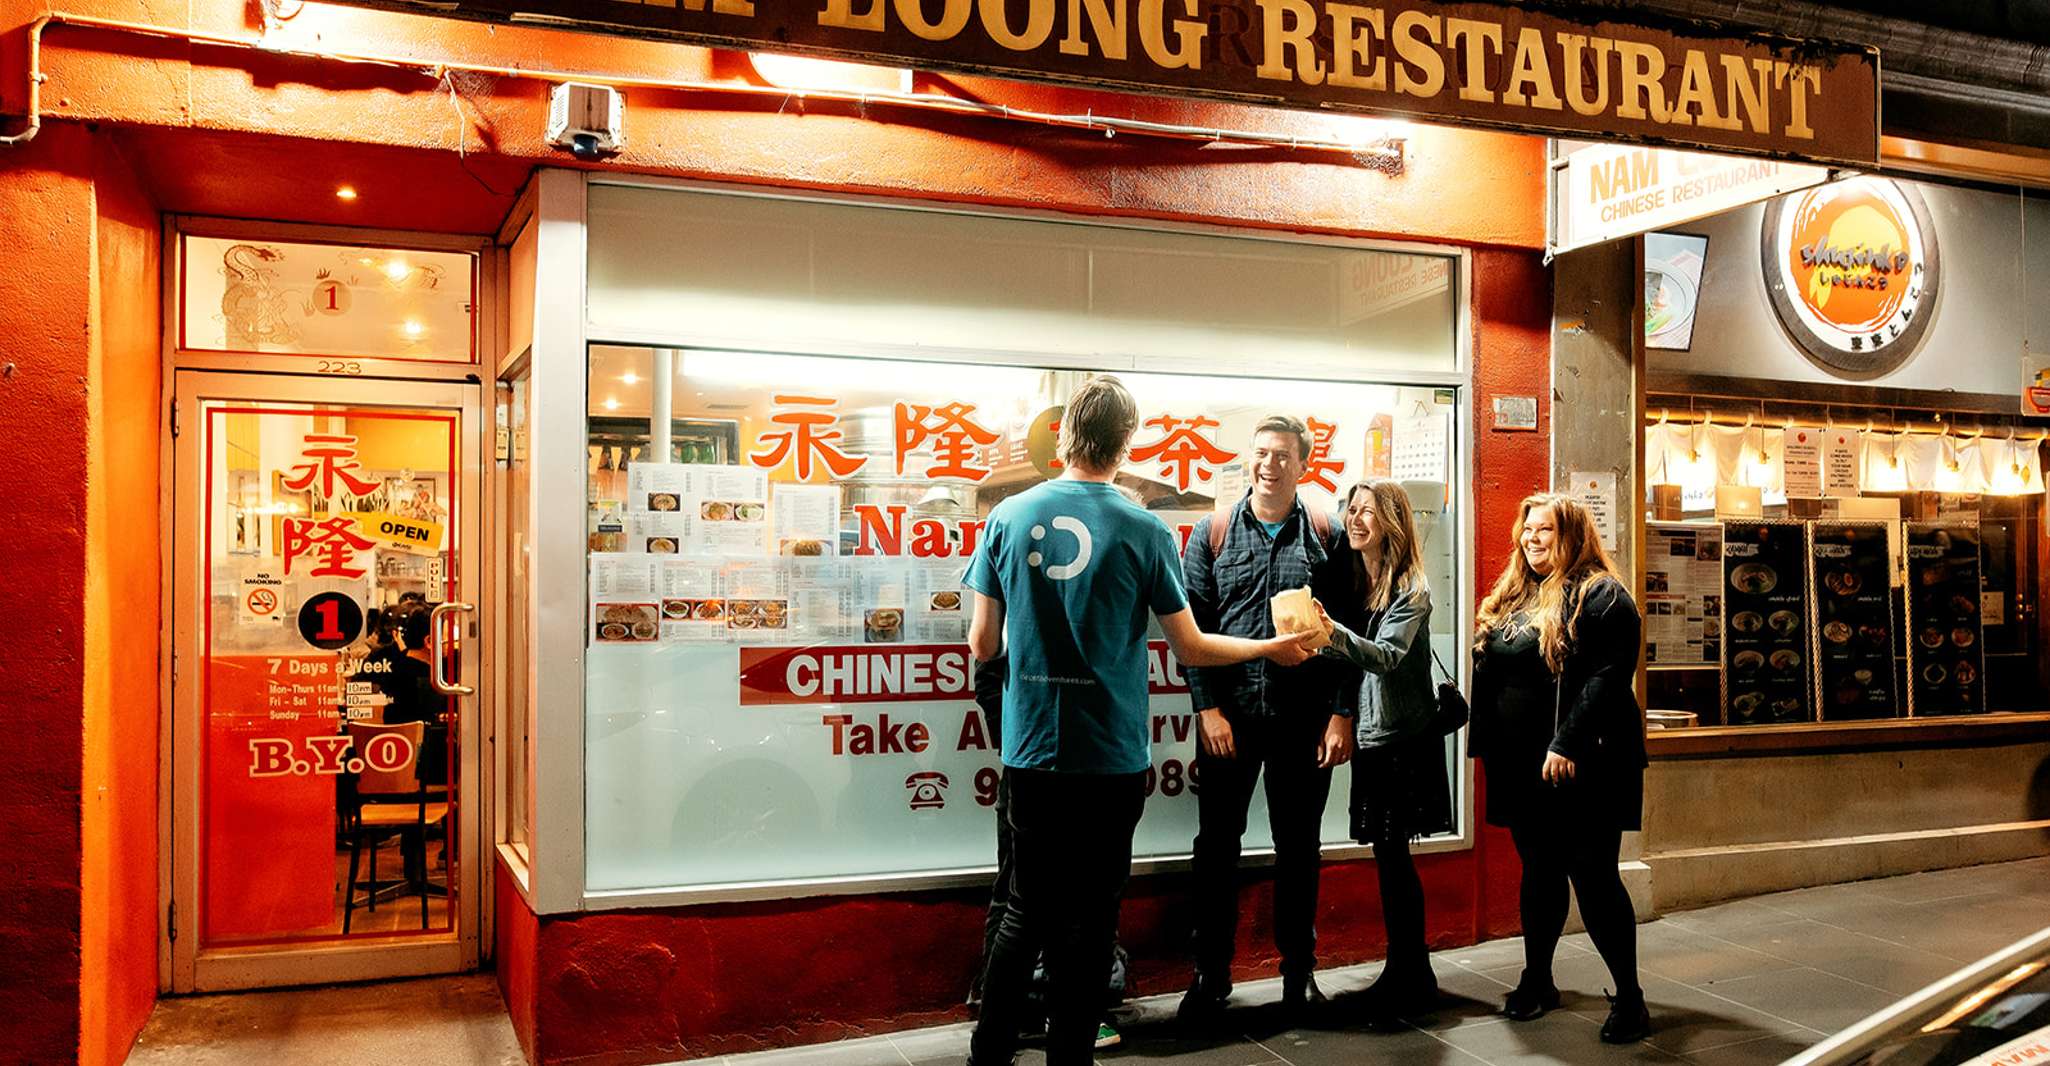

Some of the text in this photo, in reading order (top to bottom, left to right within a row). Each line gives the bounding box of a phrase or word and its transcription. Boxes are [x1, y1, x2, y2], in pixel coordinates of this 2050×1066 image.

[1256, 0, 1822, 140] RESTAURANT
[1590, 150, 1660, 204] NAM
[1601, 189, 1665, 223] CHINESE
[1672, 160, 1781, 204] RESTAURANT
[324, 286, 340, 310] 1
[318, 361, 362, 375] 223
[380, 521, 430, 542] OPEN
[314, 599, 346, 640] 1
[267, 658, 392, 677] 7 Days a Week
[269, 684, 315, 694] Mon-Thurs
[269, 696, 281, 706] Fri
[293, 696, 307, 706] Sat
[269, 710, 300, 720] Sunday
[822, 713, 930, 756] Take
[249, 732, 414, 778] B.Y.O
